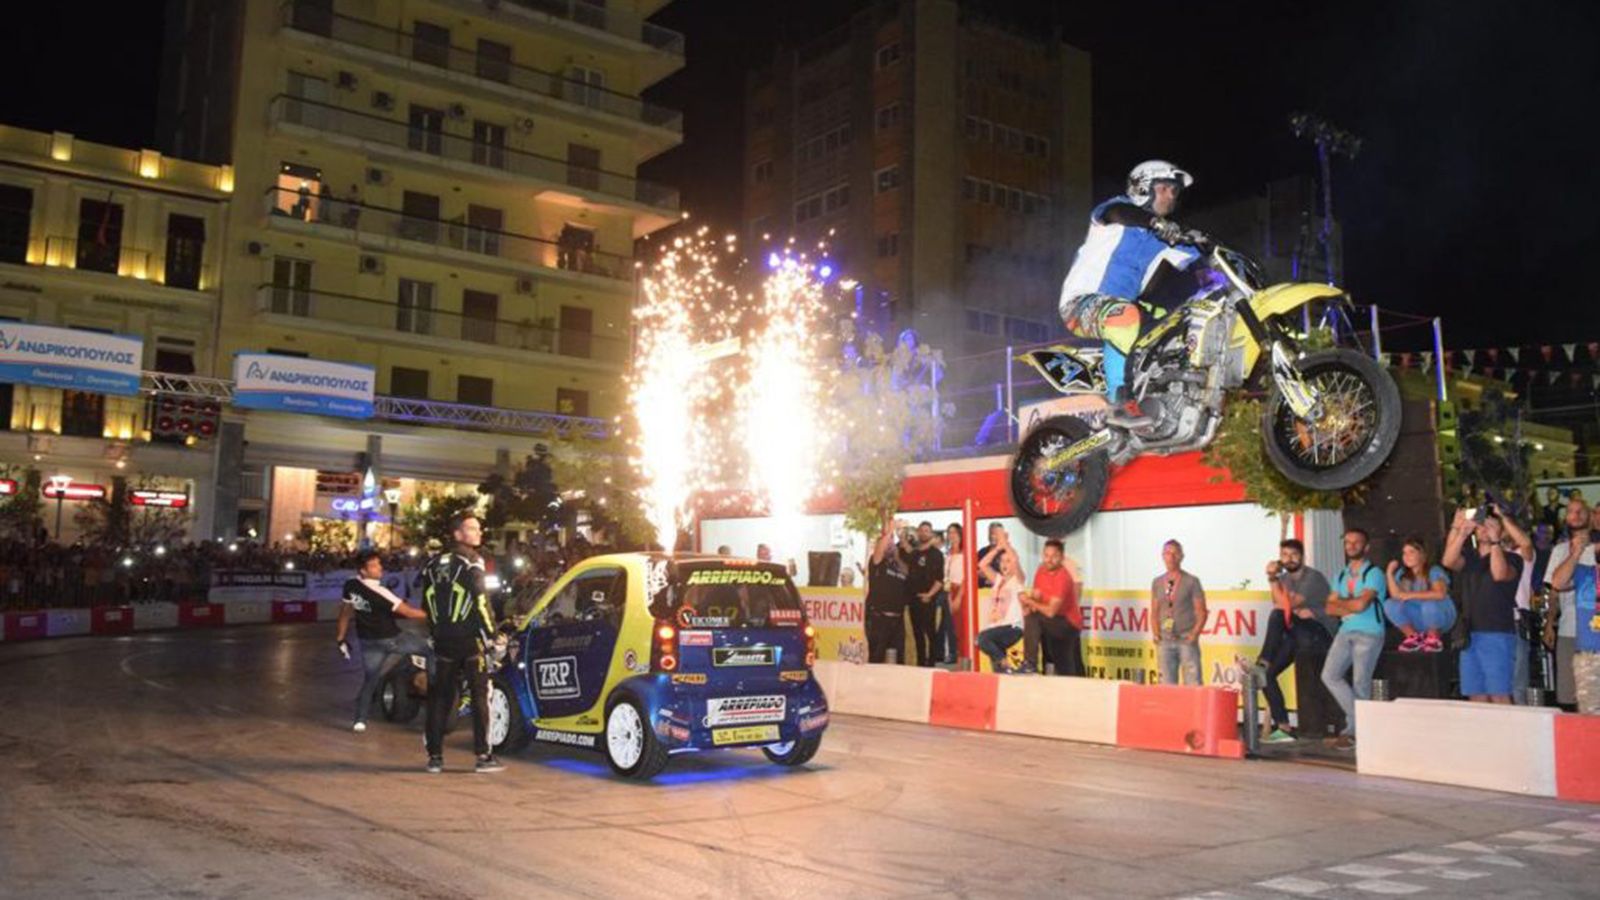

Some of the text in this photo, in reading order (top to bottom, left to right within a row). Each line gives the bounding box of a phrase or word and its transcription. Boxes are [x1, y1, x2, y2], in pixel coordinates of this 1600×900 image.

[17, 340, 135, 365] ΑΝΔΡΙΚΟΠΟΥΛΟΣ
[269, 370, 369, 392] ΑΝΔΡΙΚΟΠΟΥΛΟΣ
[804, 600, 863, 622] ERICAN
[539, 662, 570, 687] ZRP
[1086, 666, 1106, 679] ICK
[719, 697, 784, 712] ARREPIADO
